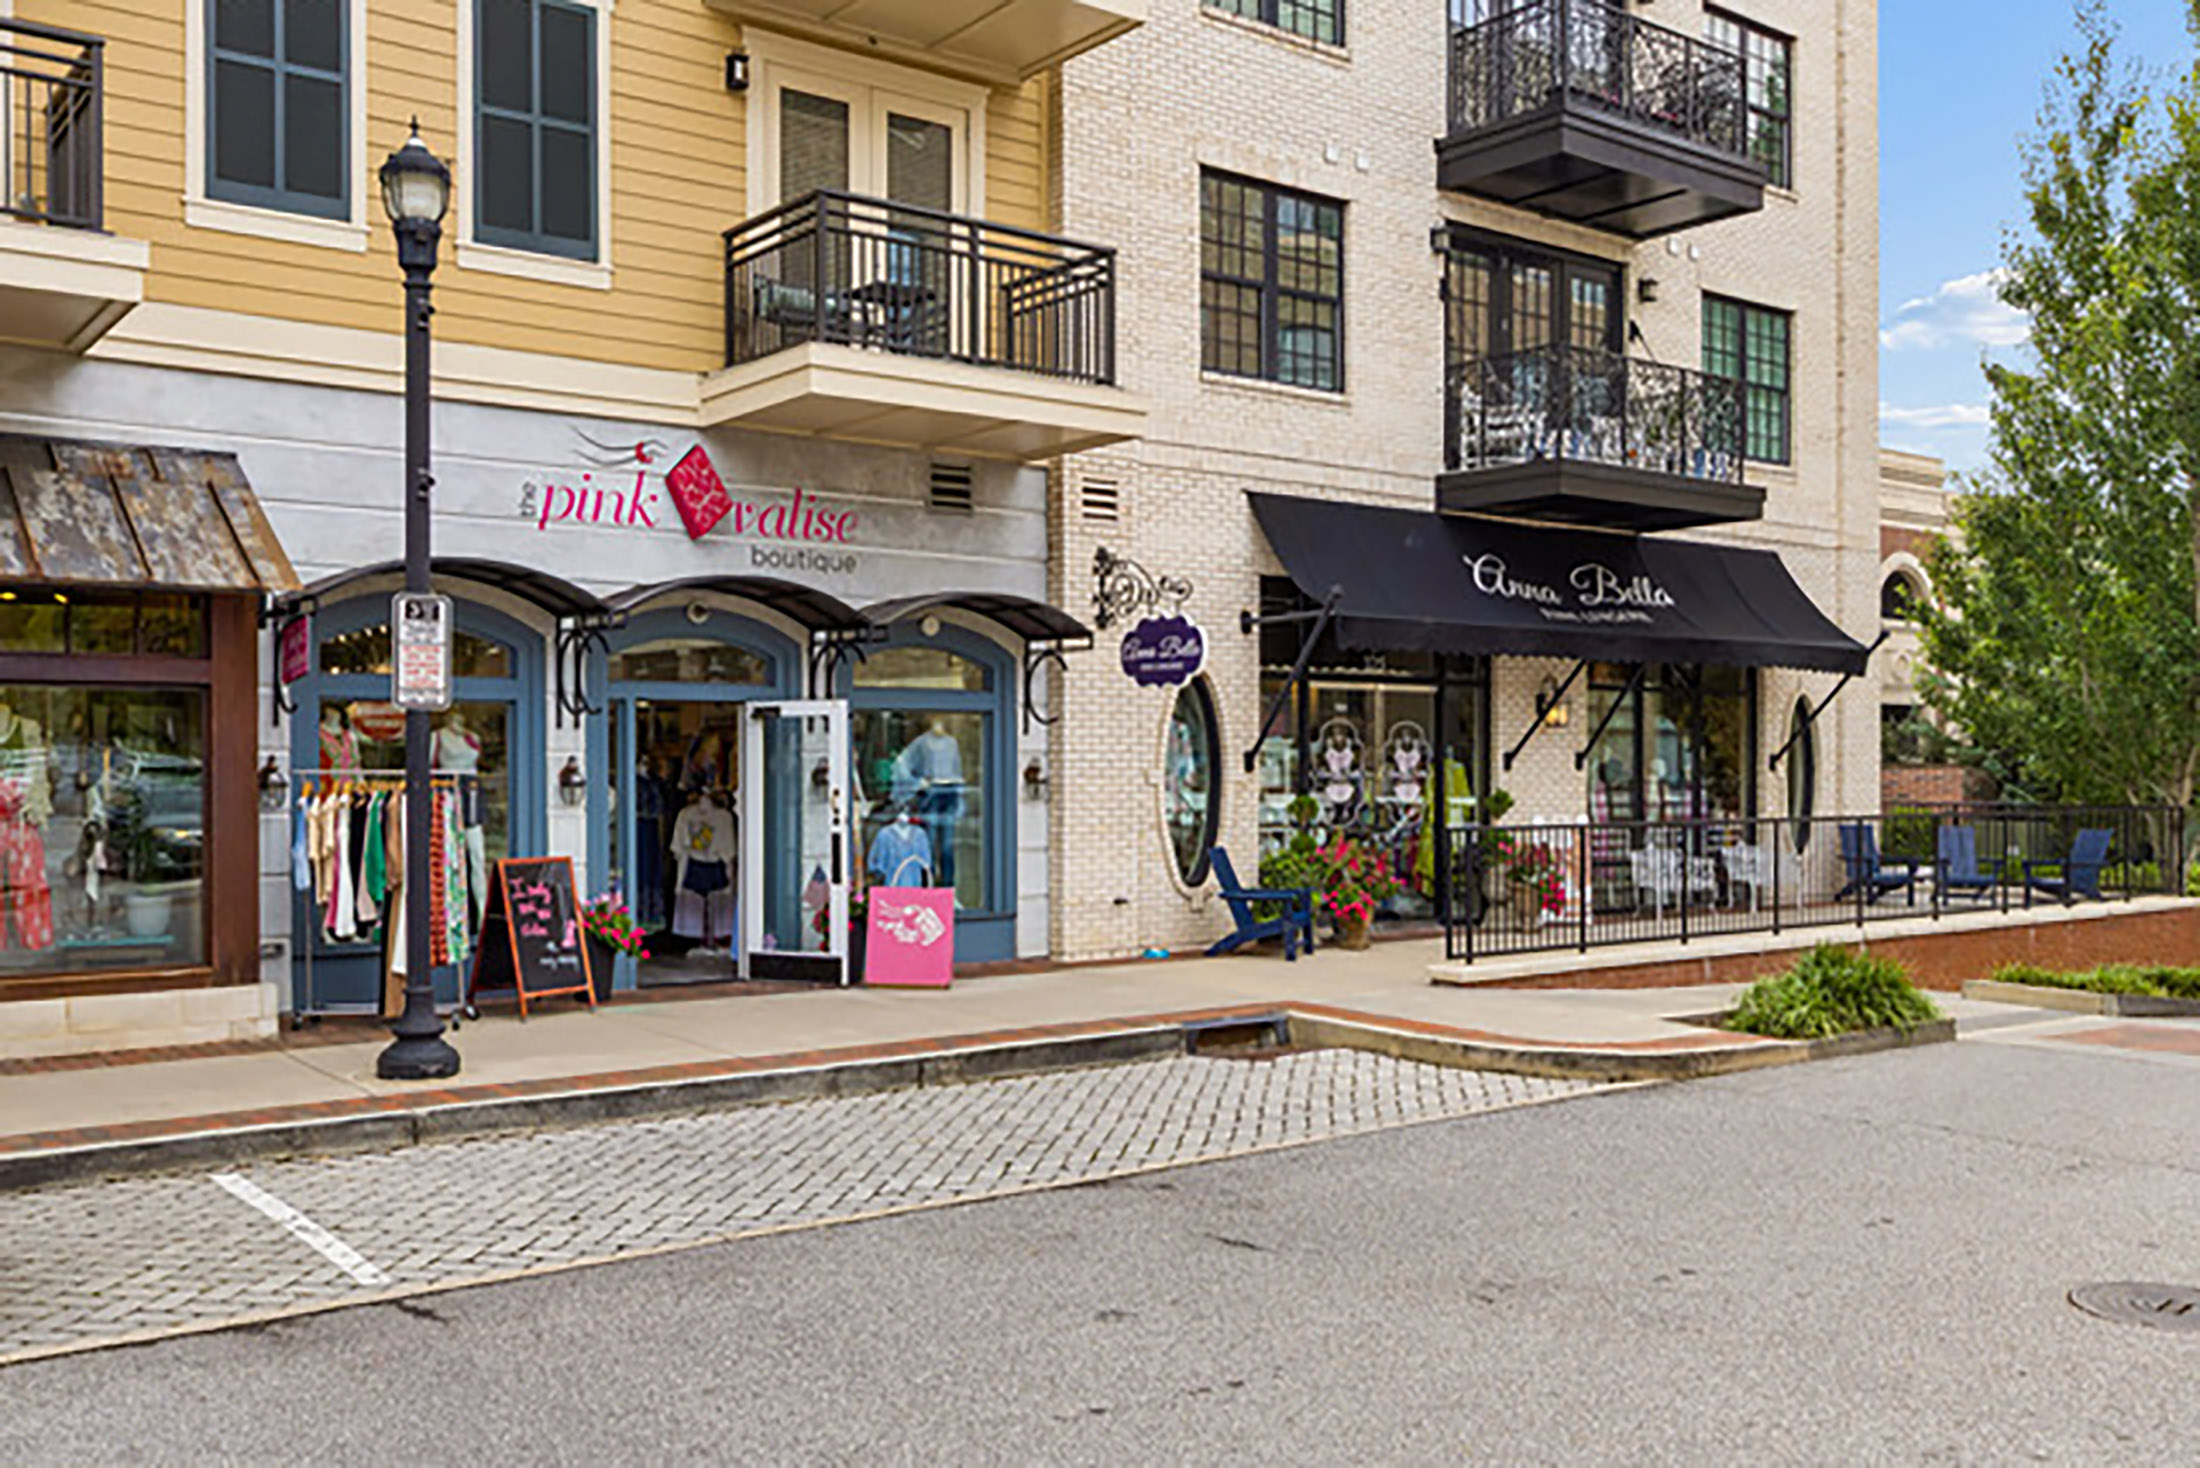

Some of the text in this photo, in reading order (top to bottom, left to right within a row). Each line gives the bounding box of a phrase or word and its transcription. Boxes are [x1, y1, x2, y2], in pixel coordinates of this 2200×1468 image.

[538, 470, 659, 531] pink
[734, 487, 859, 544] valise
[751, 546, 857, 574] boutique
[1462, 553, 1676, 607] Anna Bella
